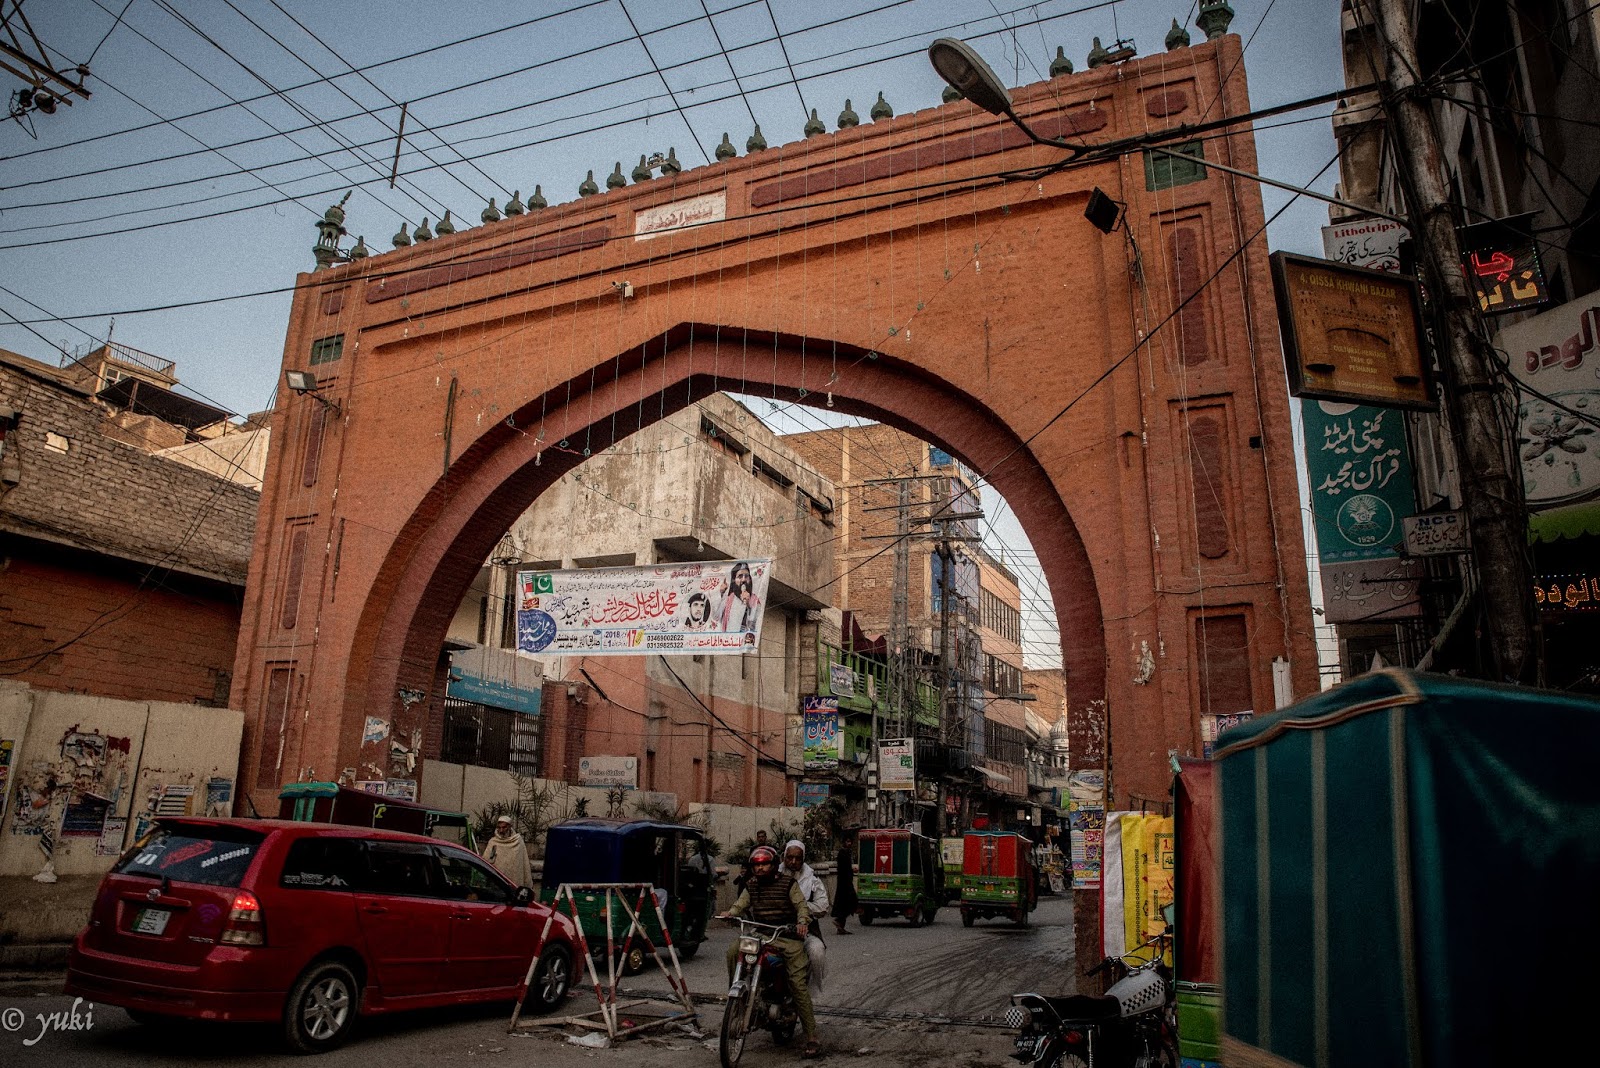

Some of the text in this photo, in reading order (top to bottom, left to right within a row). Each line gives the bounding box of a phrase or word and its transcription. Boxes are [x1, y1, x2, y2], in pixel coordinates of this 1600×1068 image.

[1335, 222, 1402, 239] Lithotripsy
[1309, 275, 1336, 289] QISSA
[1336, 279, 1370, 295] KHWANI
[1370, 284, 1398, 300] BAZAR
[1317, 448, 1401, 496] قرآن مجید
[626, 629, 637, 647] 17
